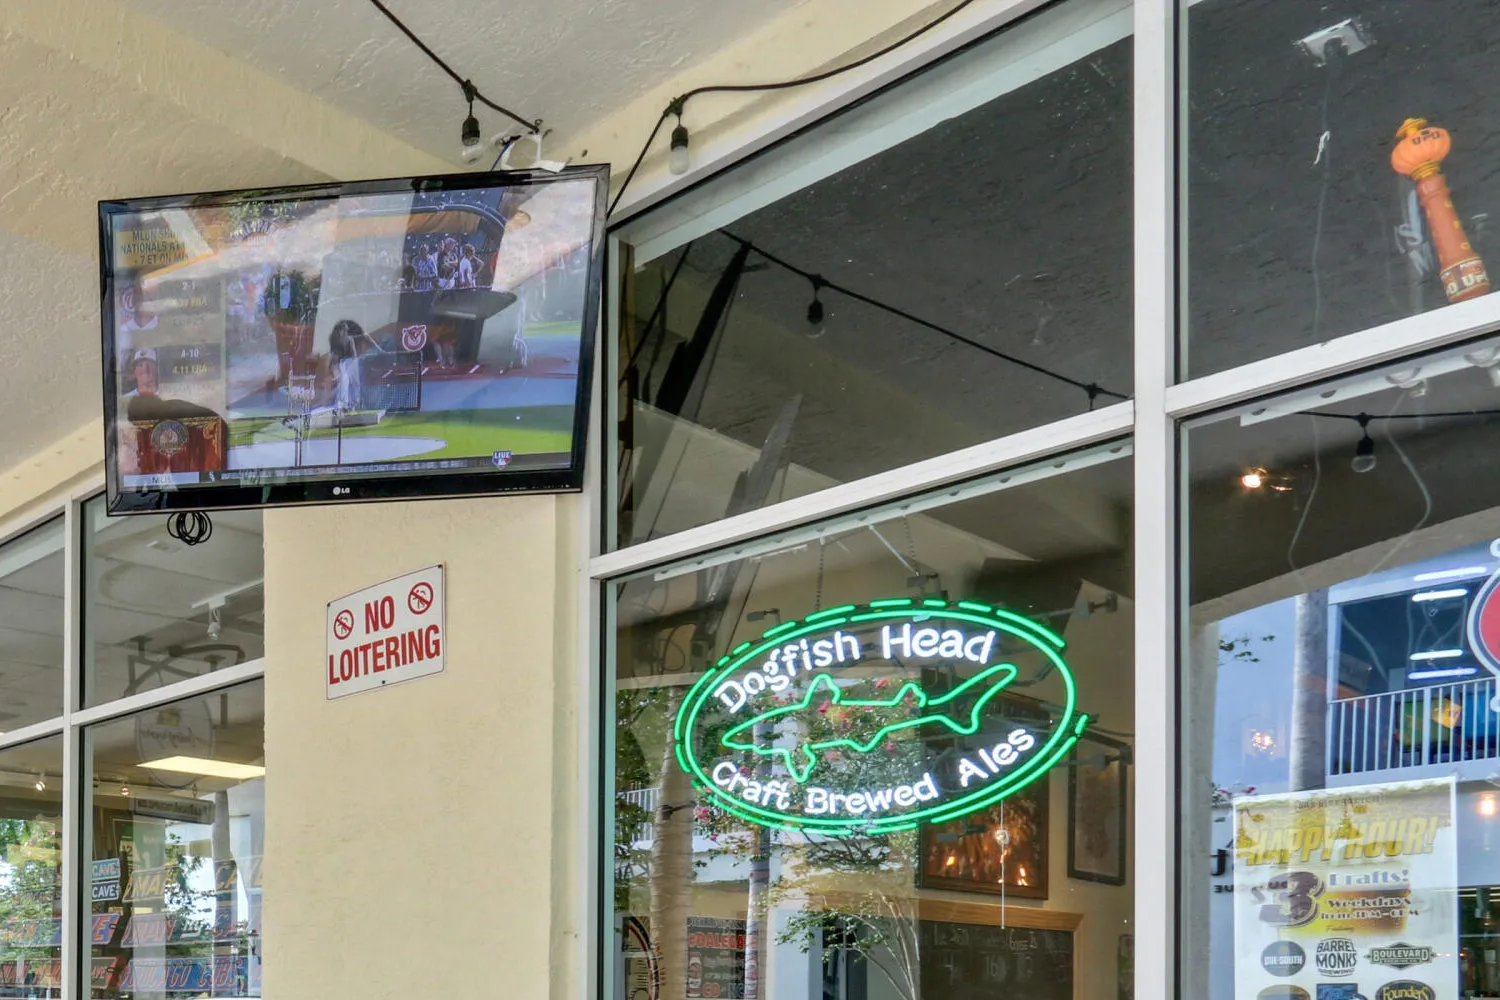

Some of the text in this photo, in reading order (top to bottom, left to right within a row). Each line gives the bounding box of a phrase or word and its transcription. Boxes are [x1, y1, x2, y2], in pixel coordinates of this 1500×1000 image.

[121, 241, 167, 254] NATIONALS
[365, 595, 395, 634] NO
[329, 624, 441, 685] LOITERING
[713, 624, 996, 713] Dogfish Head
[712, 727, 1035, 814] Craft Brewed Ales
[1247, 825, 1336, 866] HAPPY
[1344, 816, 1439, 860] HOUR!
[92, 863, 117, 877] CAVE
[1329, 869, 1409, 886] Drafts!
[92, 884, 116, 898] CAVE
[1316, 939, 1356, 953] BARREL
[1373, 946, 1429, 962] BOULEVARD
[1315, 953, 1357, 968] MONKS
